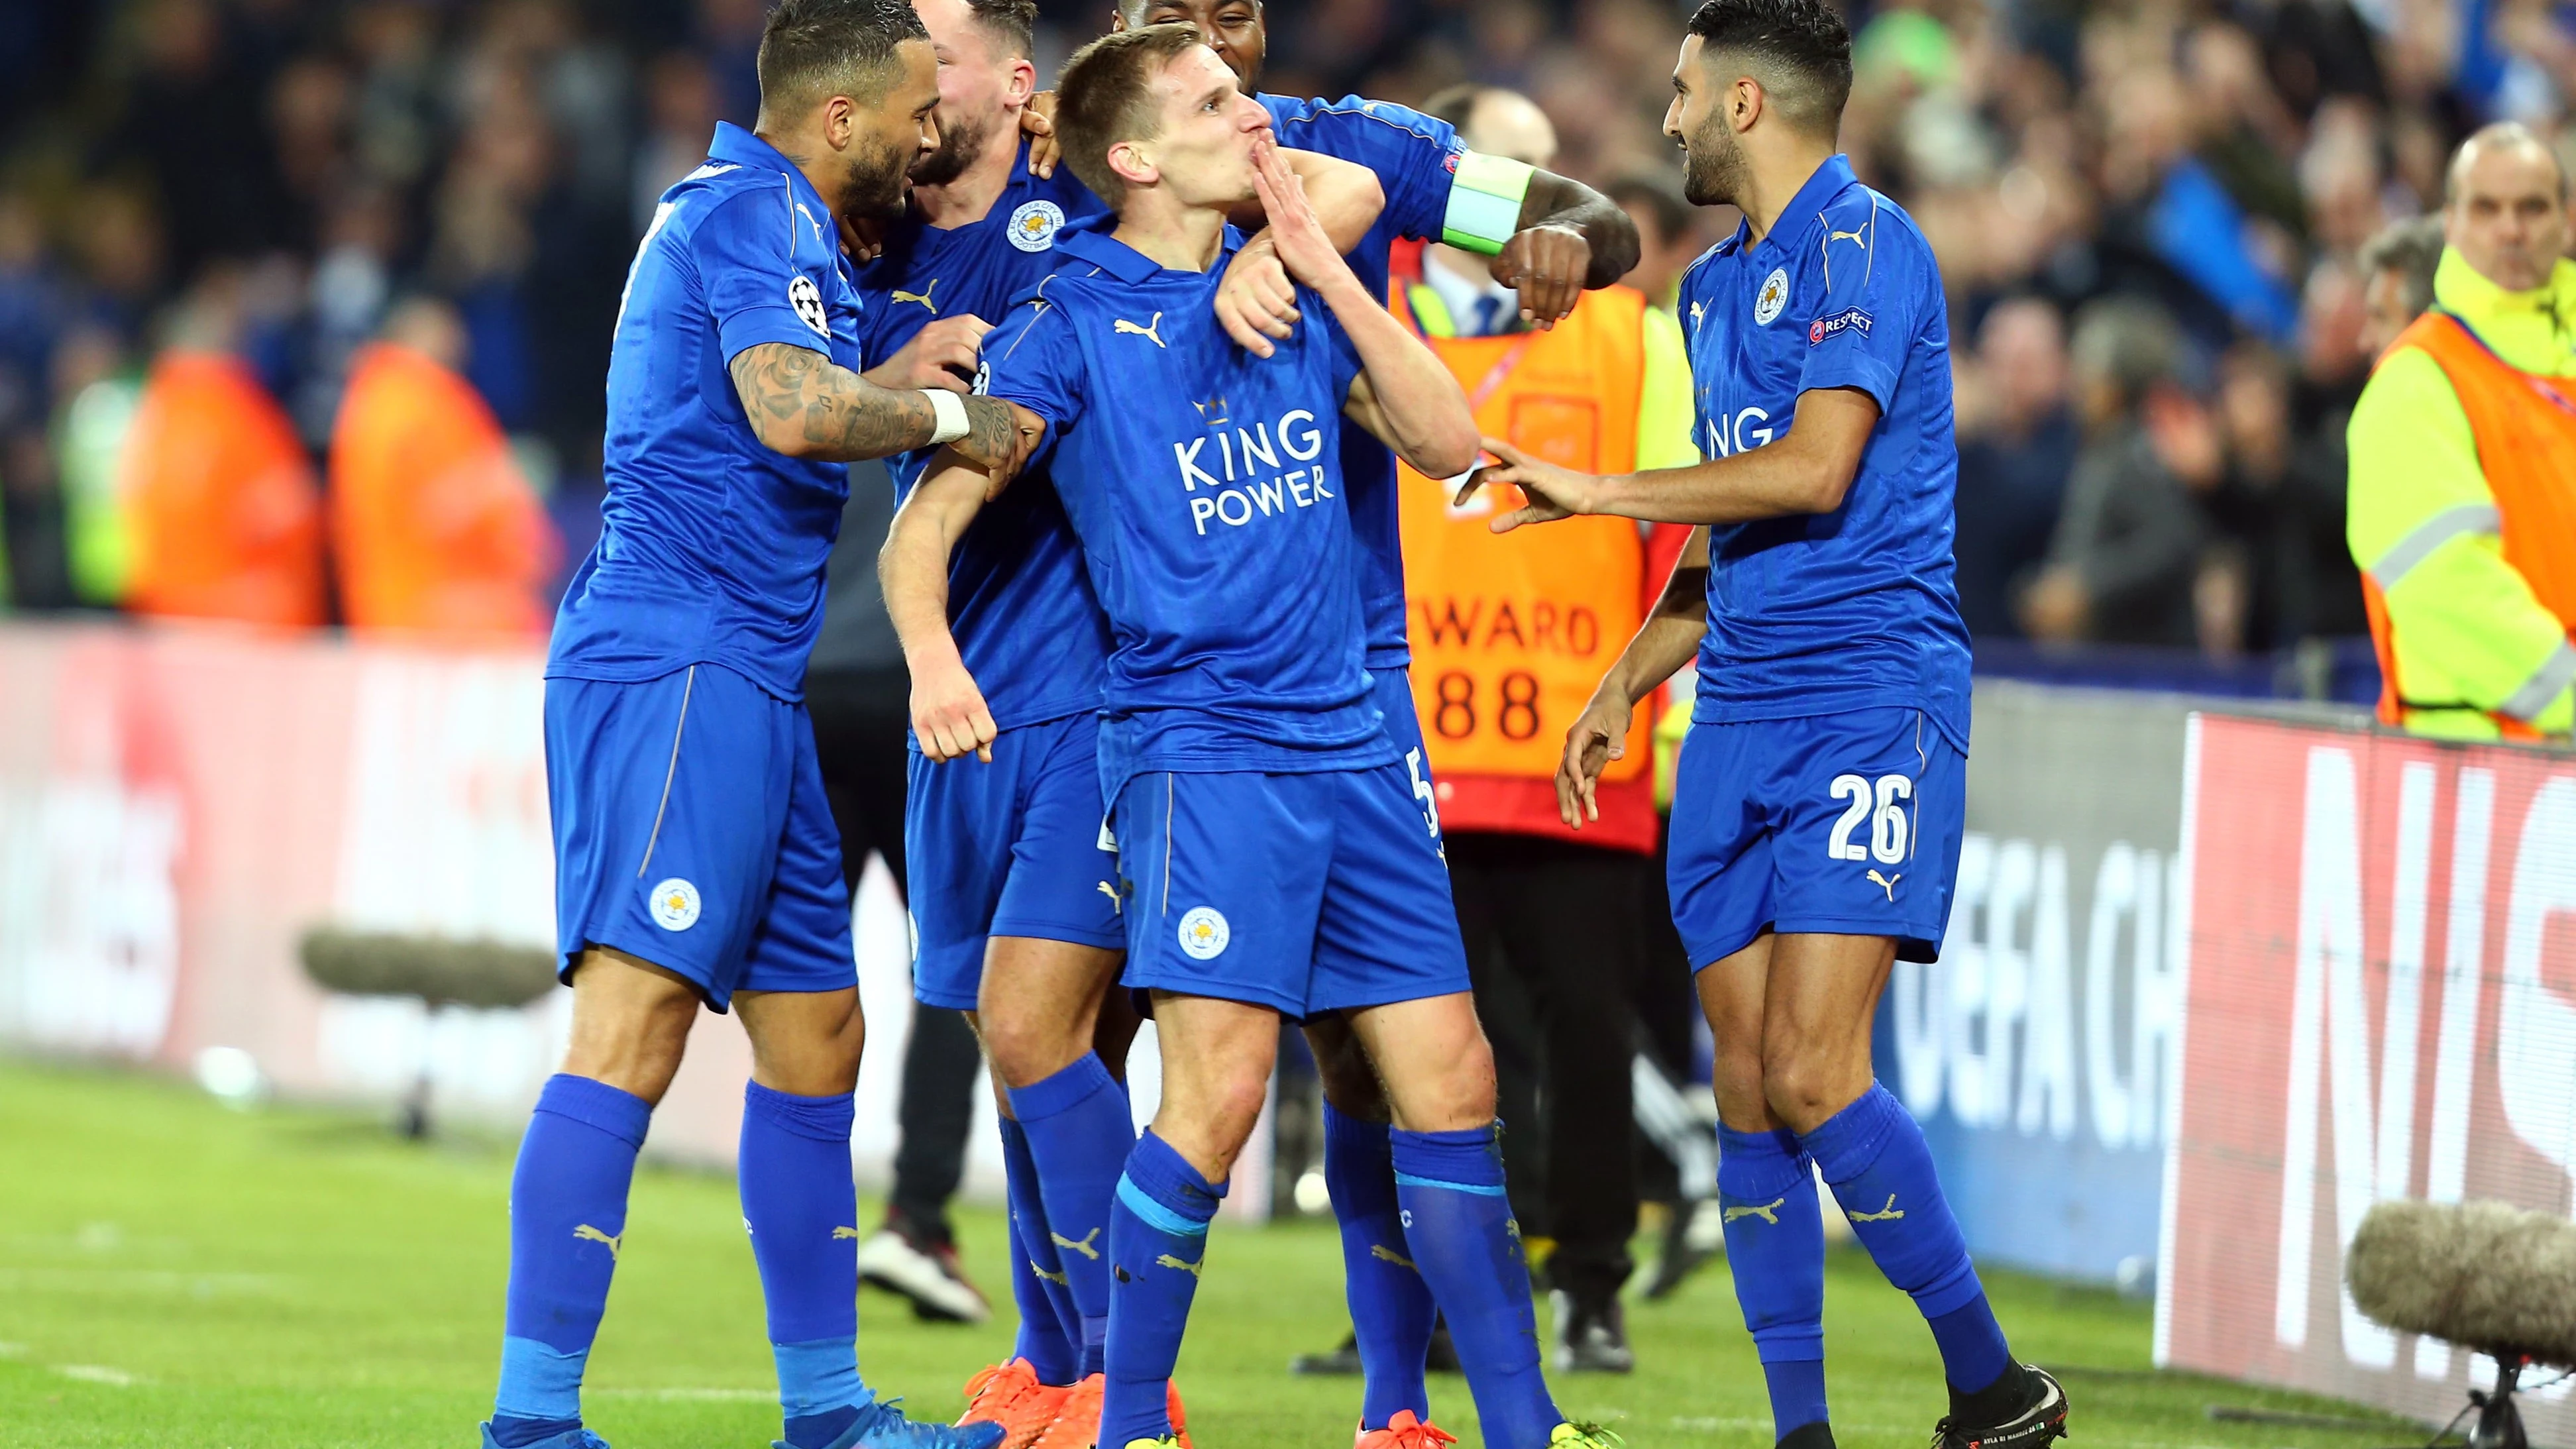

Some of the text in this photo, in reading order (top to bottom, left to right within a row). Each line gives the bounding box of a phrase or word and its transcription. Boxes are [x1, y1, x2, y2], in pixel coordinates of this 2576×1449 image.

[1009, 203, 1058, 234] LEICESTER CITY
[1825, 311, 1873, 333] RESPECT
[1173, 409, 1322, 492] KING
[1190, 464, 1335, 536] POWER
[1435, 671, 1539, 741] 88
[1405, 745, 1439, 838] 5
[1828, 774, 1913, 865] 26
[1893, 832, 2076, 1142] UEFA
